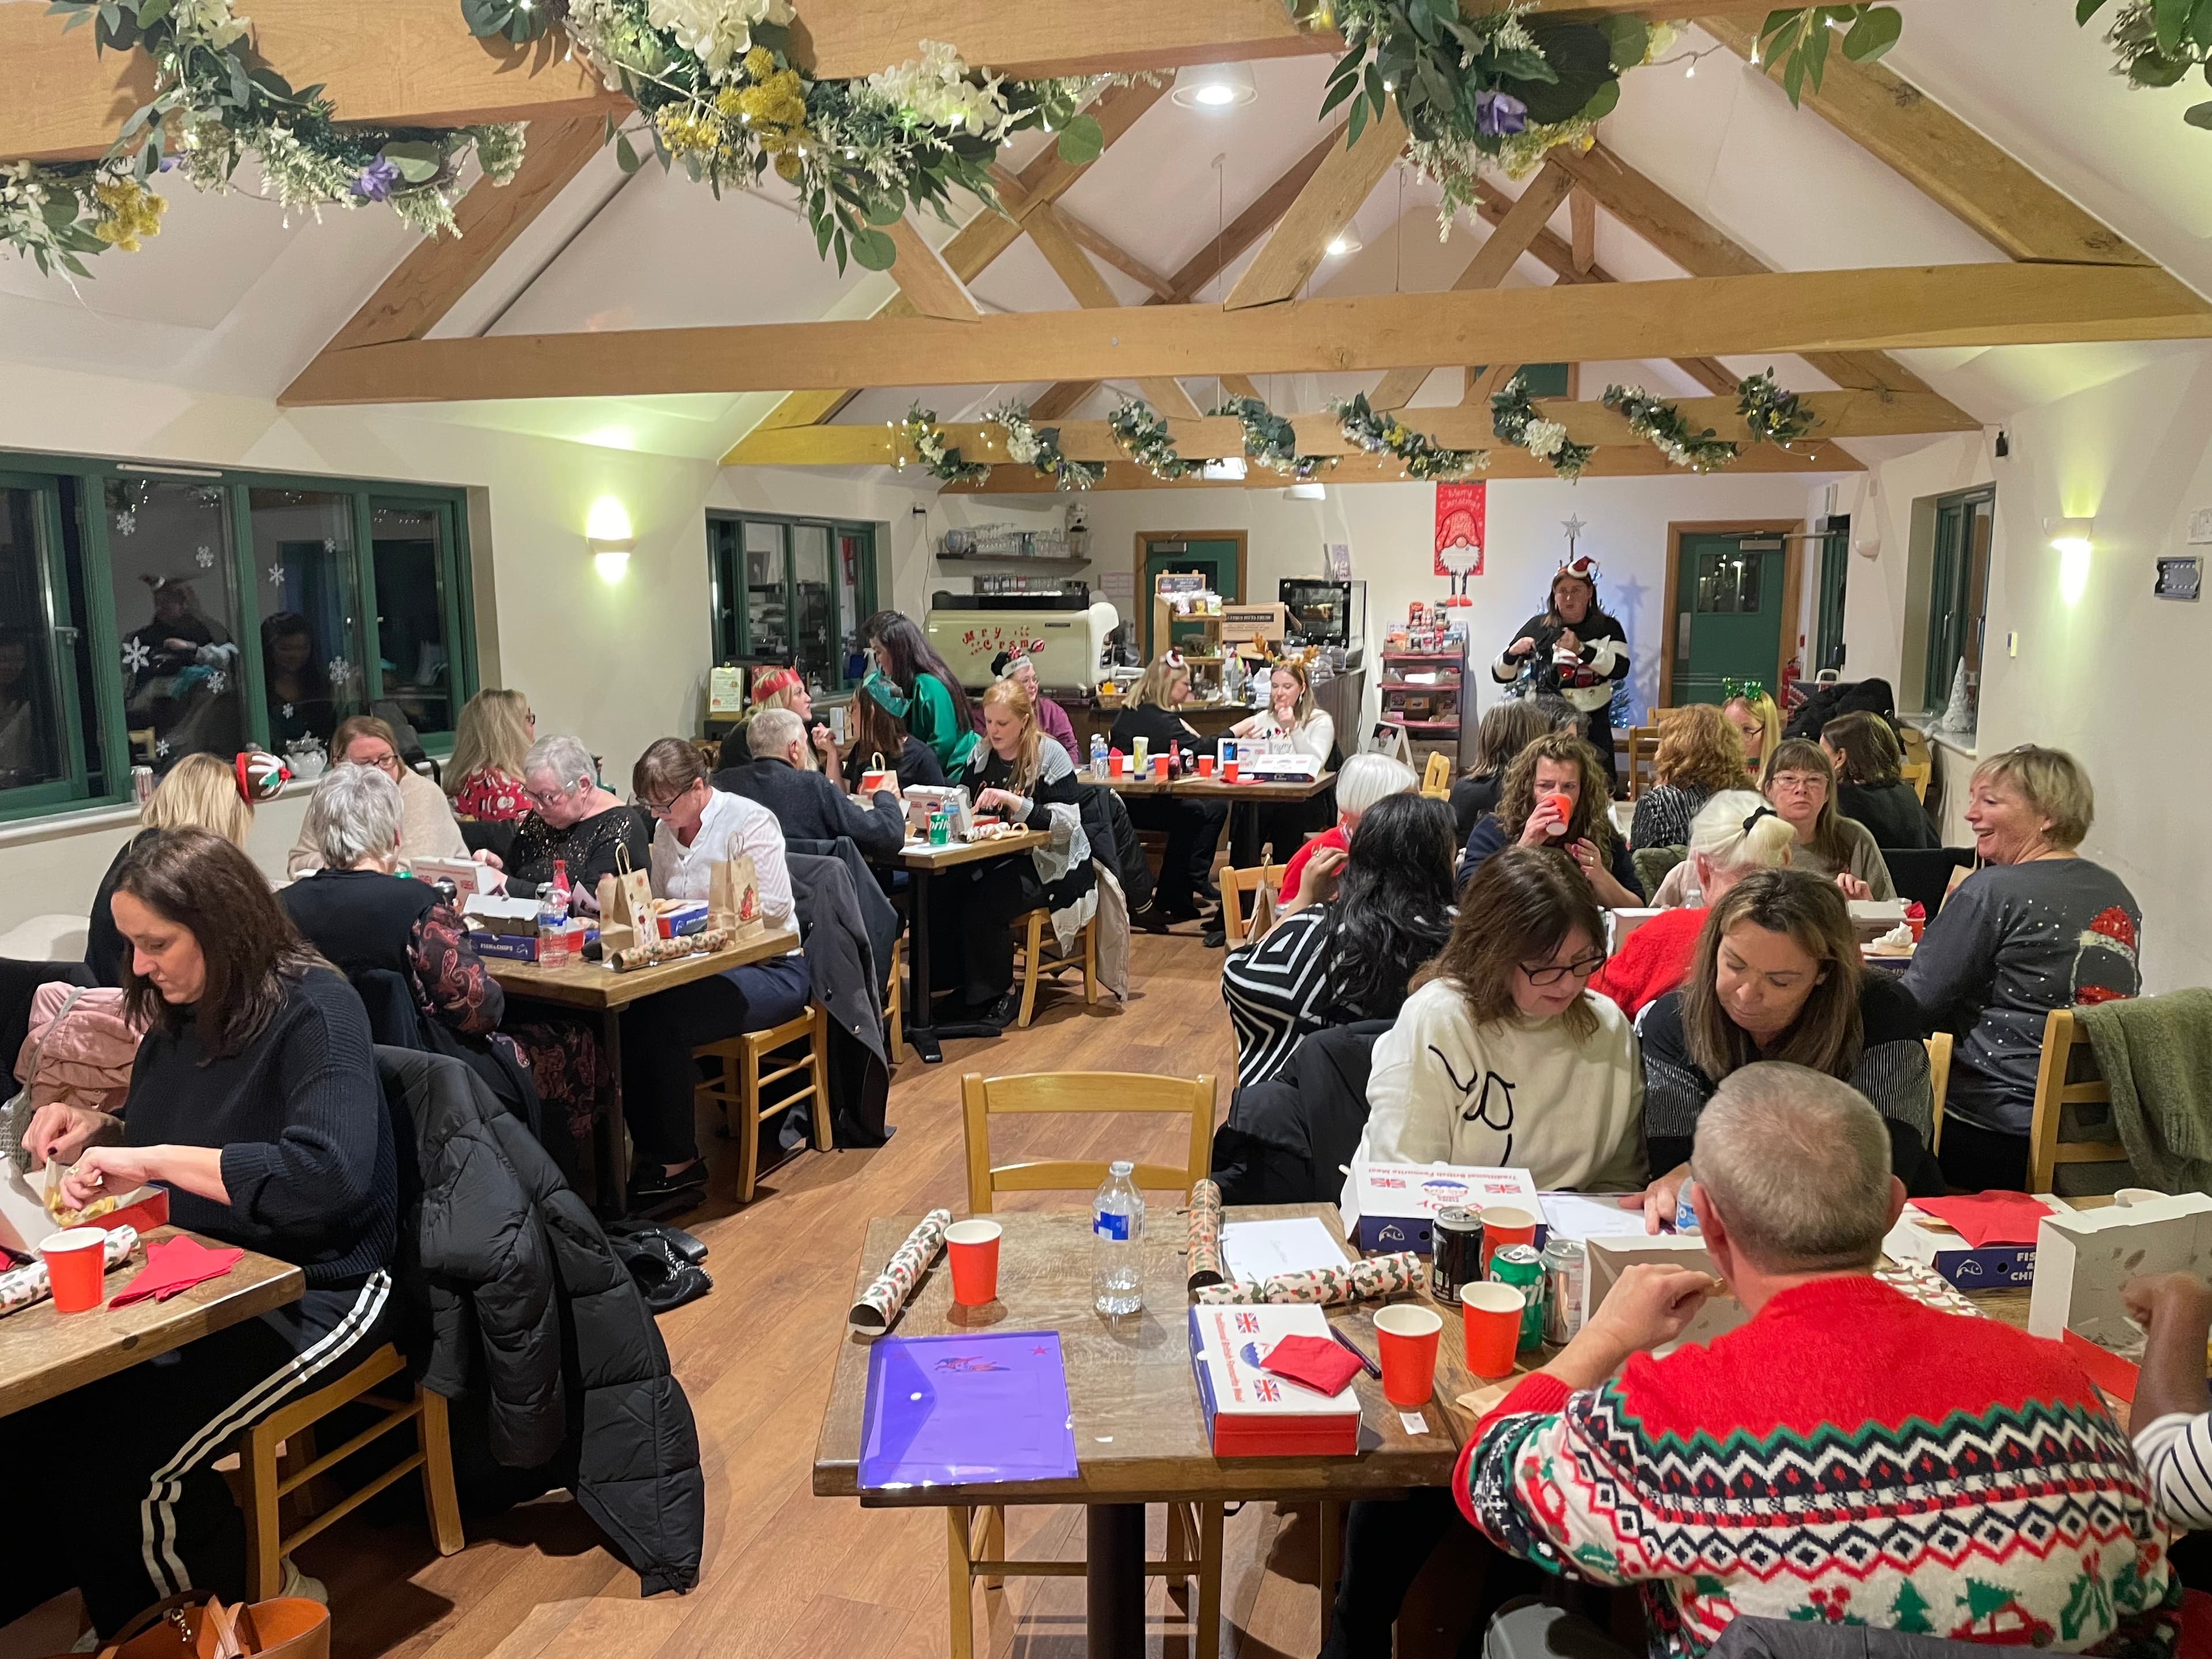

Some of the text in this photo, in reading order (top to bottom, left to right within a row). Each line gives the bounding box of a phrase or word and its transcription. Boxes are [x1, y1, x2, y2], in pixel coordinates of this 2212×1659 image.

[1448, 488, 1472, 498] Merry
[929, 818, 950, 831] prit
[2017, 1252, 2036, 1262] FIS
[2010, 1271, 2033, 1281] CHI
